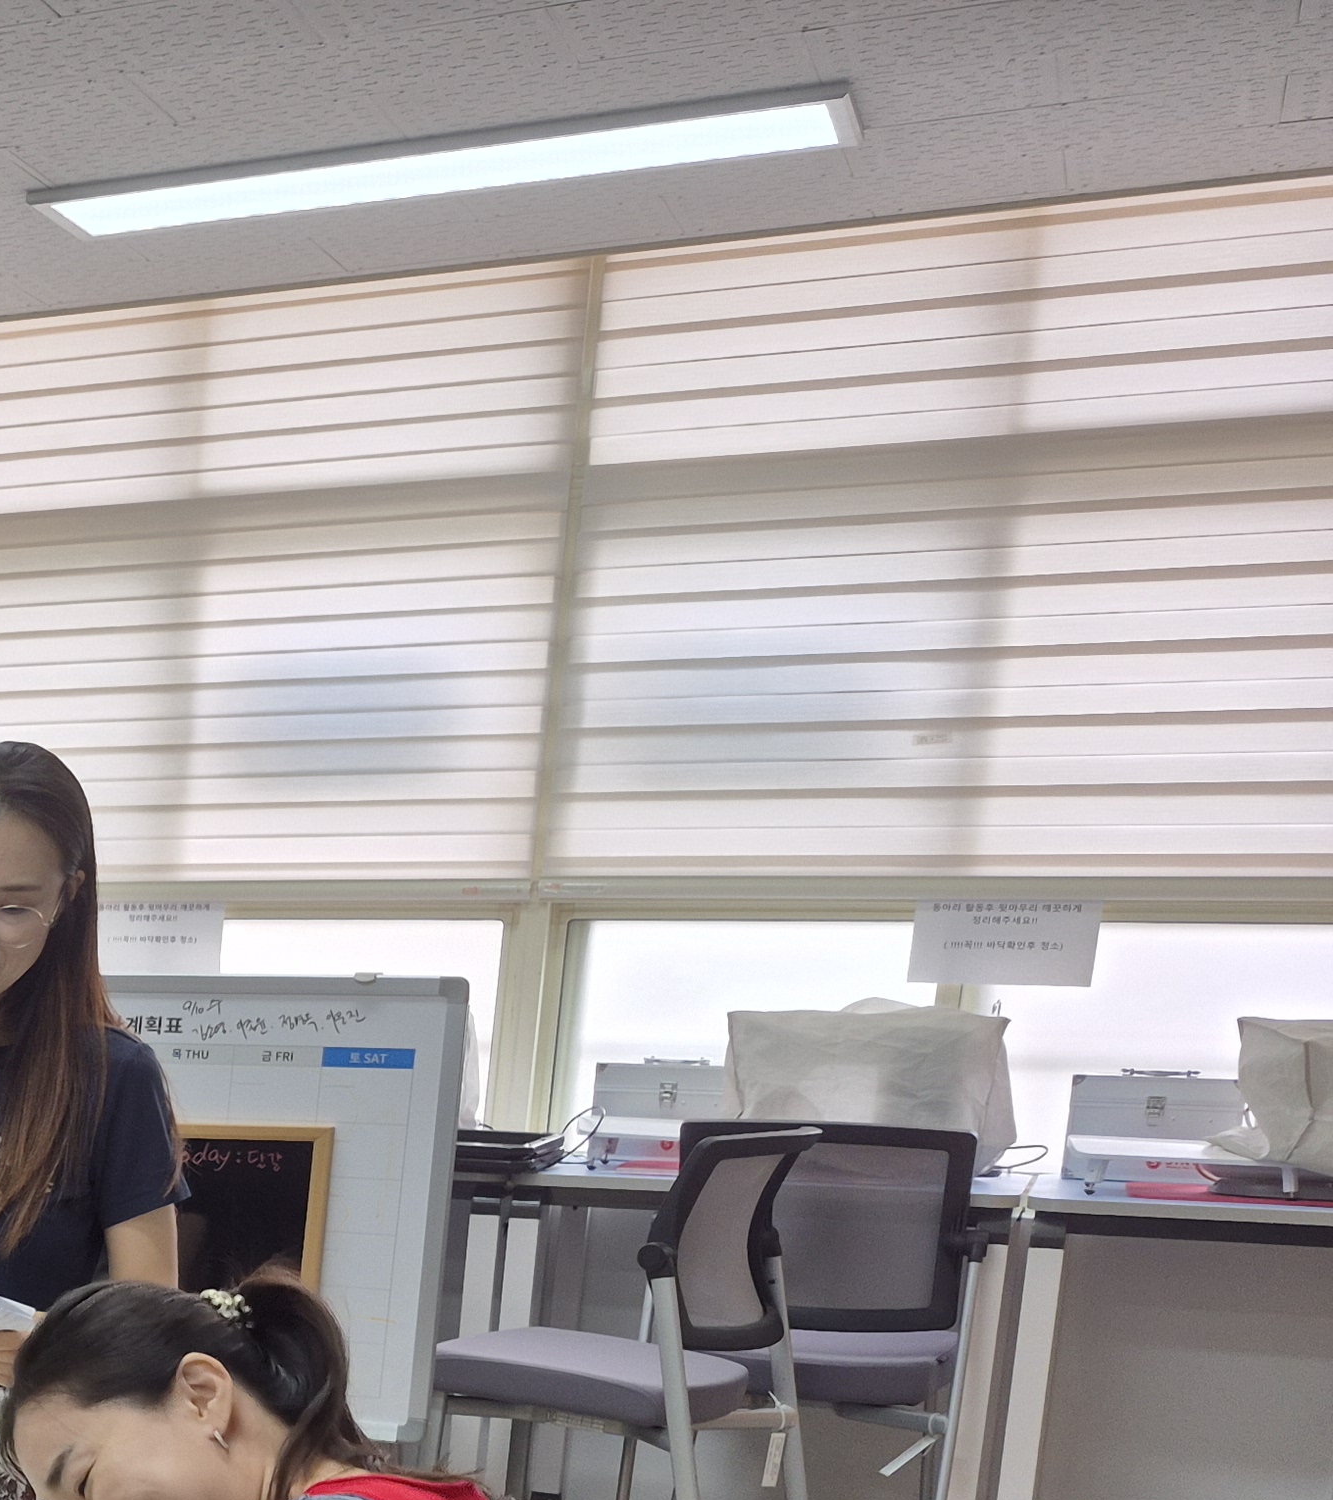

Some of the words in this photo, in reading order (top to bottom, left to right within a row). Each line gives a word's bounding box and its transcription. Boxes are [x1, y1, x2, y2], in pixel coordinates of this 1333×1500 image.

[172, 1048, 182, 1060] 목
[186, 1050, 209, 1060] THU
[261, 1051, 272, 1062] 금
[276, 1051, 294, 1062] FRI
[349, 1052, 360, 1063] 토
[364, 1052, 388, 1064] SAT
